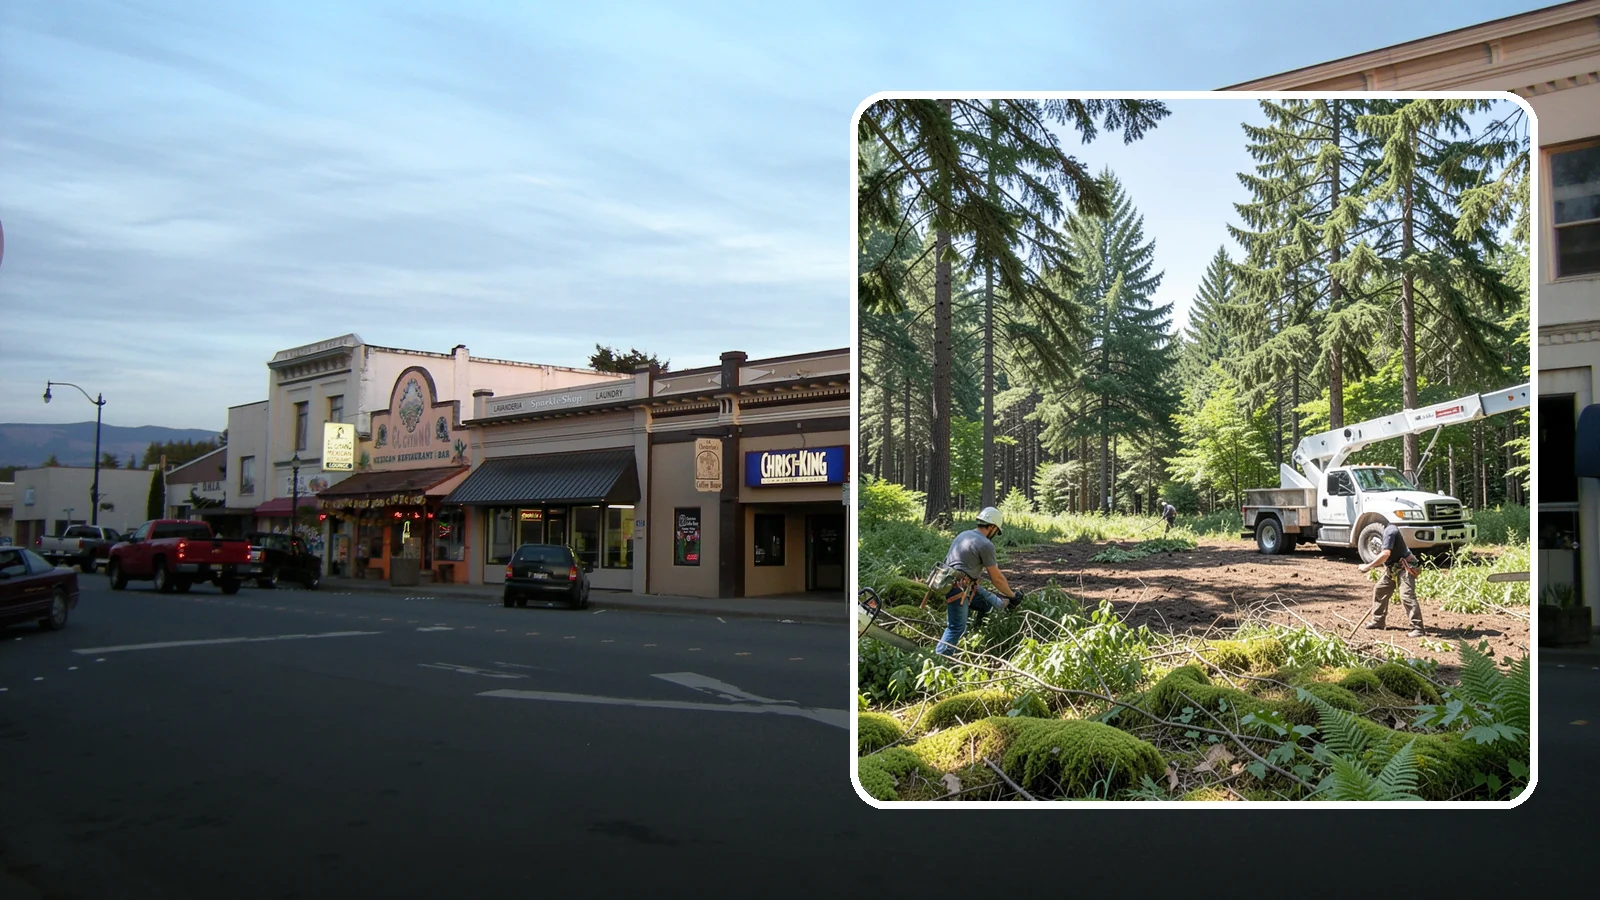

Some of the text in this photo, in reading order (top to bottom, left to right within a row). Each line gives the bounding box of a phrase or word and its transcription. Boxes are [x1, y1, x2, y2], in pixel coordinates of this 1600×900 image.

[493, 388, 624, 412] LAVANDERIA Sparkle Shop LAUNDRY
[373, 454, 396, 464] MEXICAN
[397, 451, 433, 462] RESTAURANT
[437, 450, 450, 459] BAR
[761, 450, 828, 478] CHRIST KING
